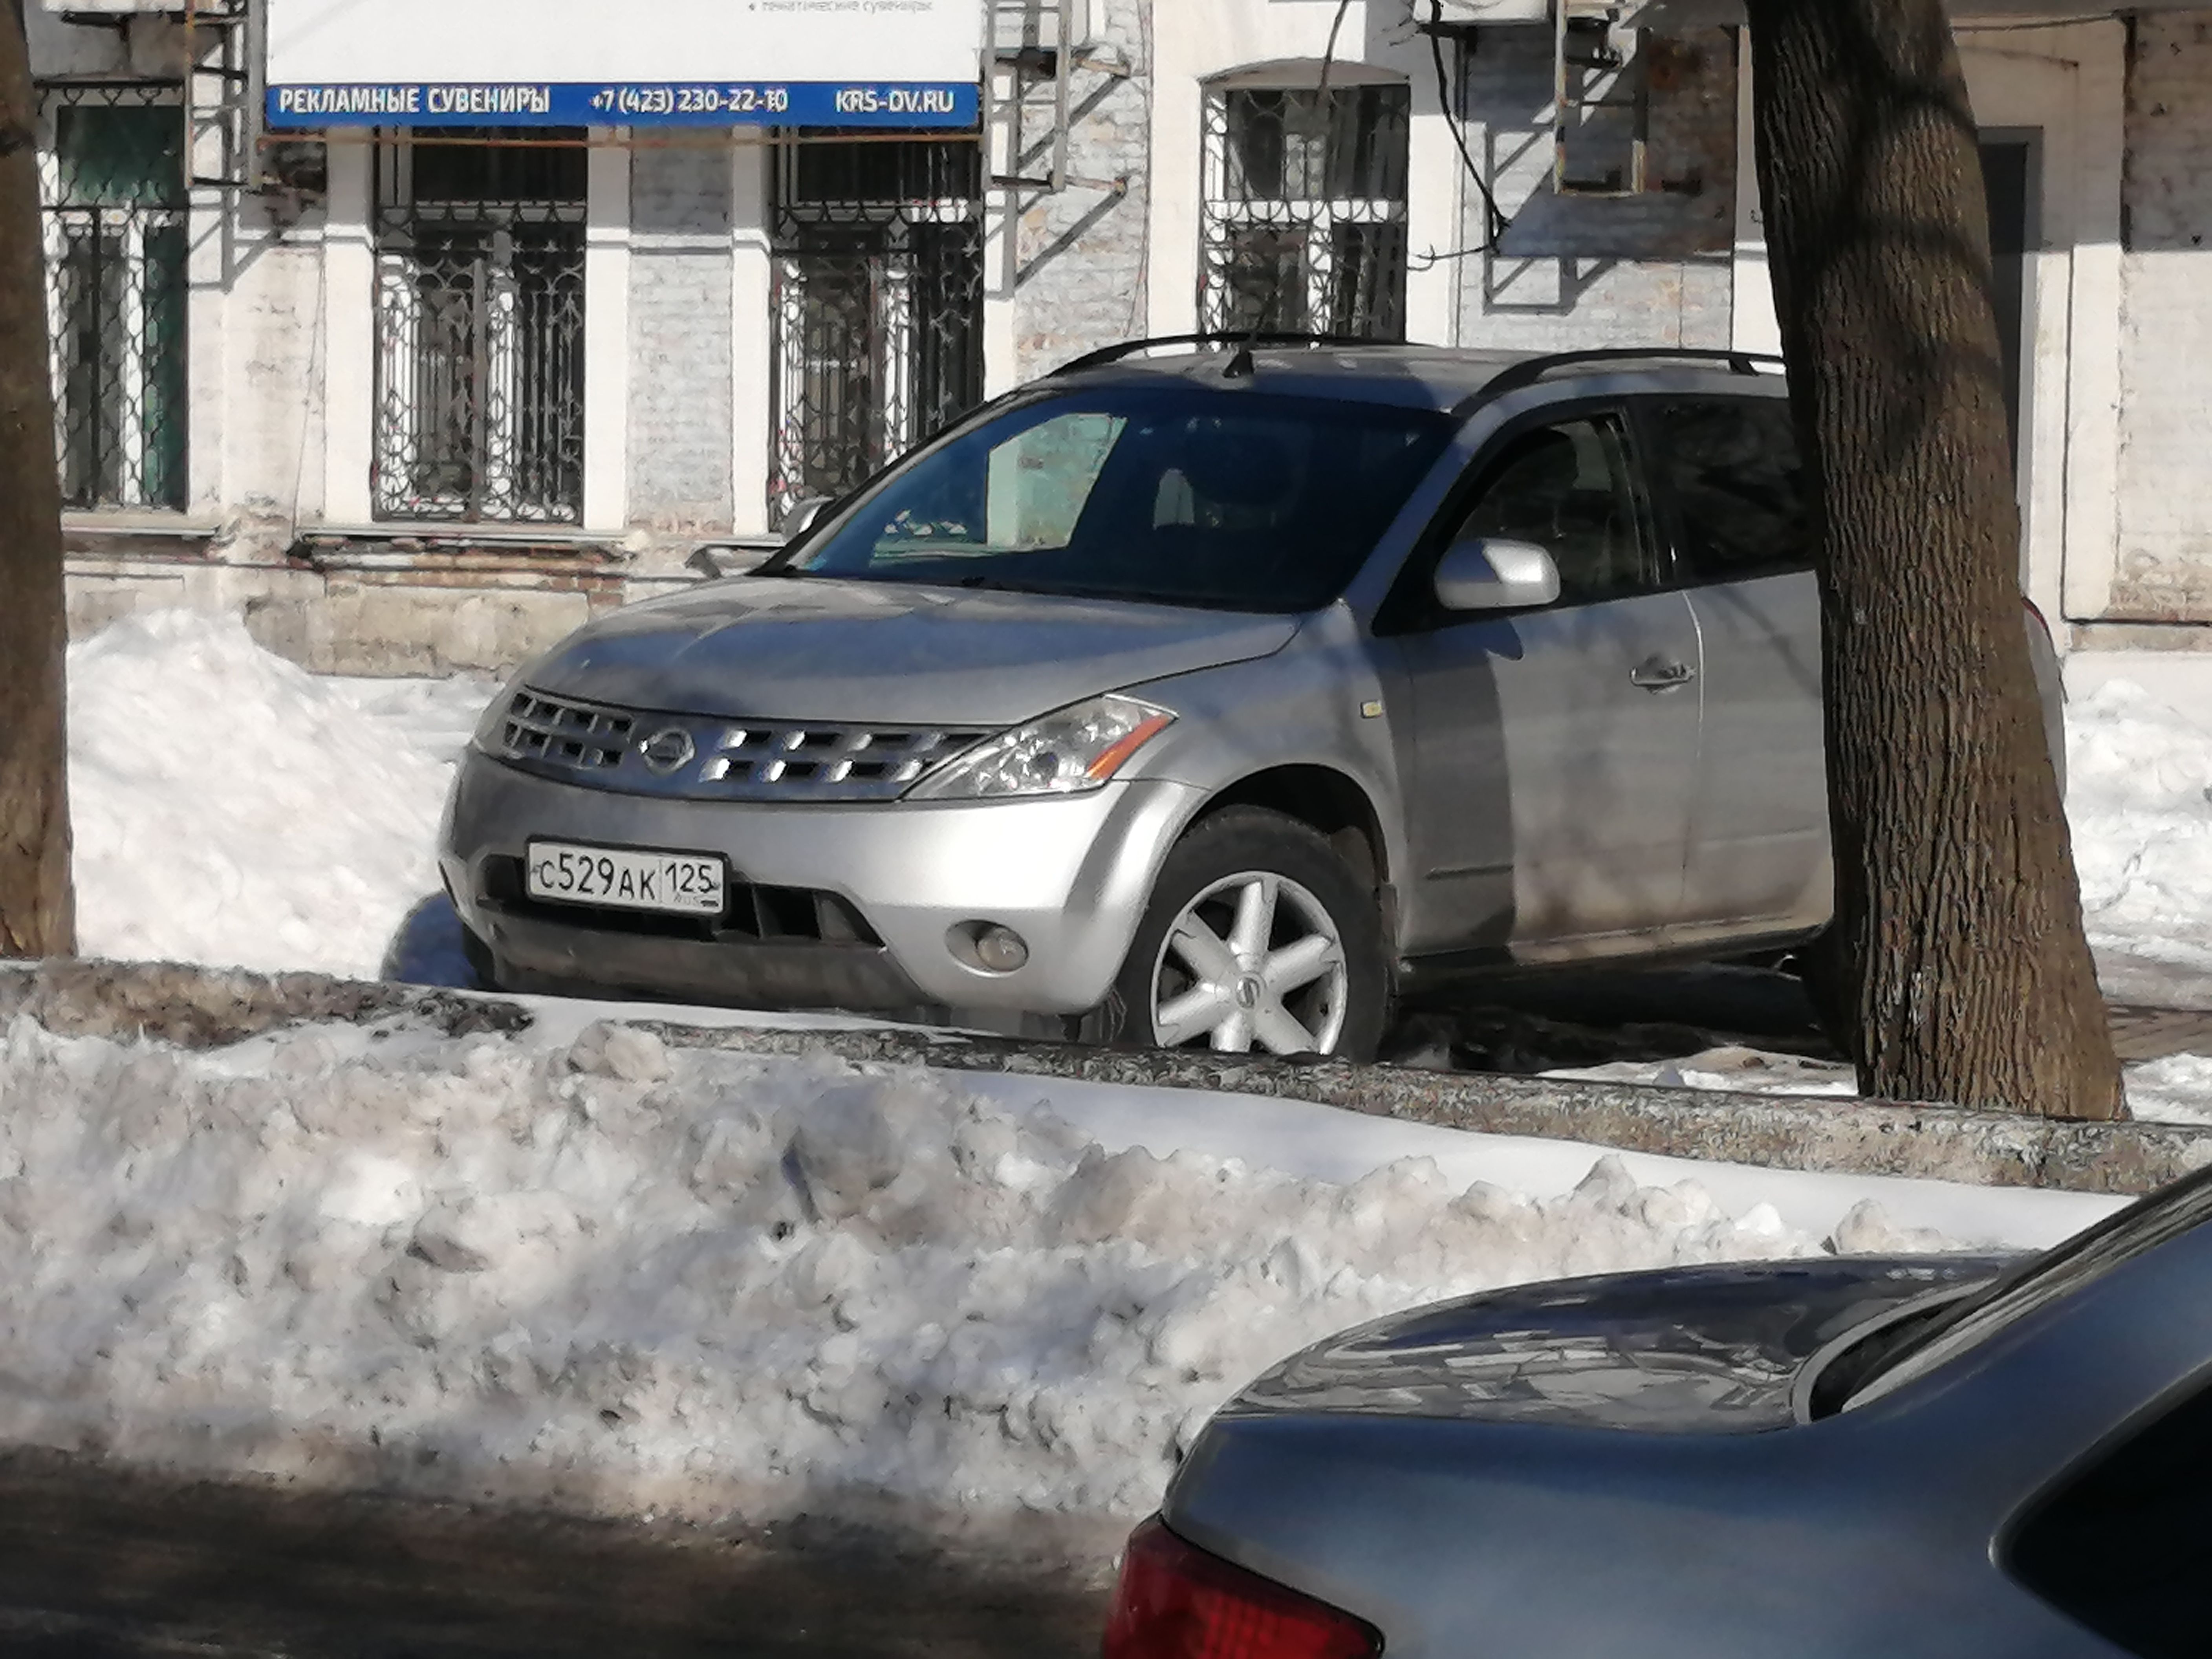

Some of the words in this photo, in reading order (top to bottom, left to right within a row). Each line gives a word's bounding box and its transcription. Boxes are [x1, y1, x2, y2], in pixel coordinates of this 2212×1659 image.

[279, 88, 420, 113] РЕКЛАМНЫЕ
[428, 87, 549, 113] СУВЕНИРЫ
[591, 89, 613, 112] +7
[617, 89, 674, 114] (423)
[678, 89, 787, 112] 230-22-10
[835, 90, 954, 112] KRS-DV.RU
